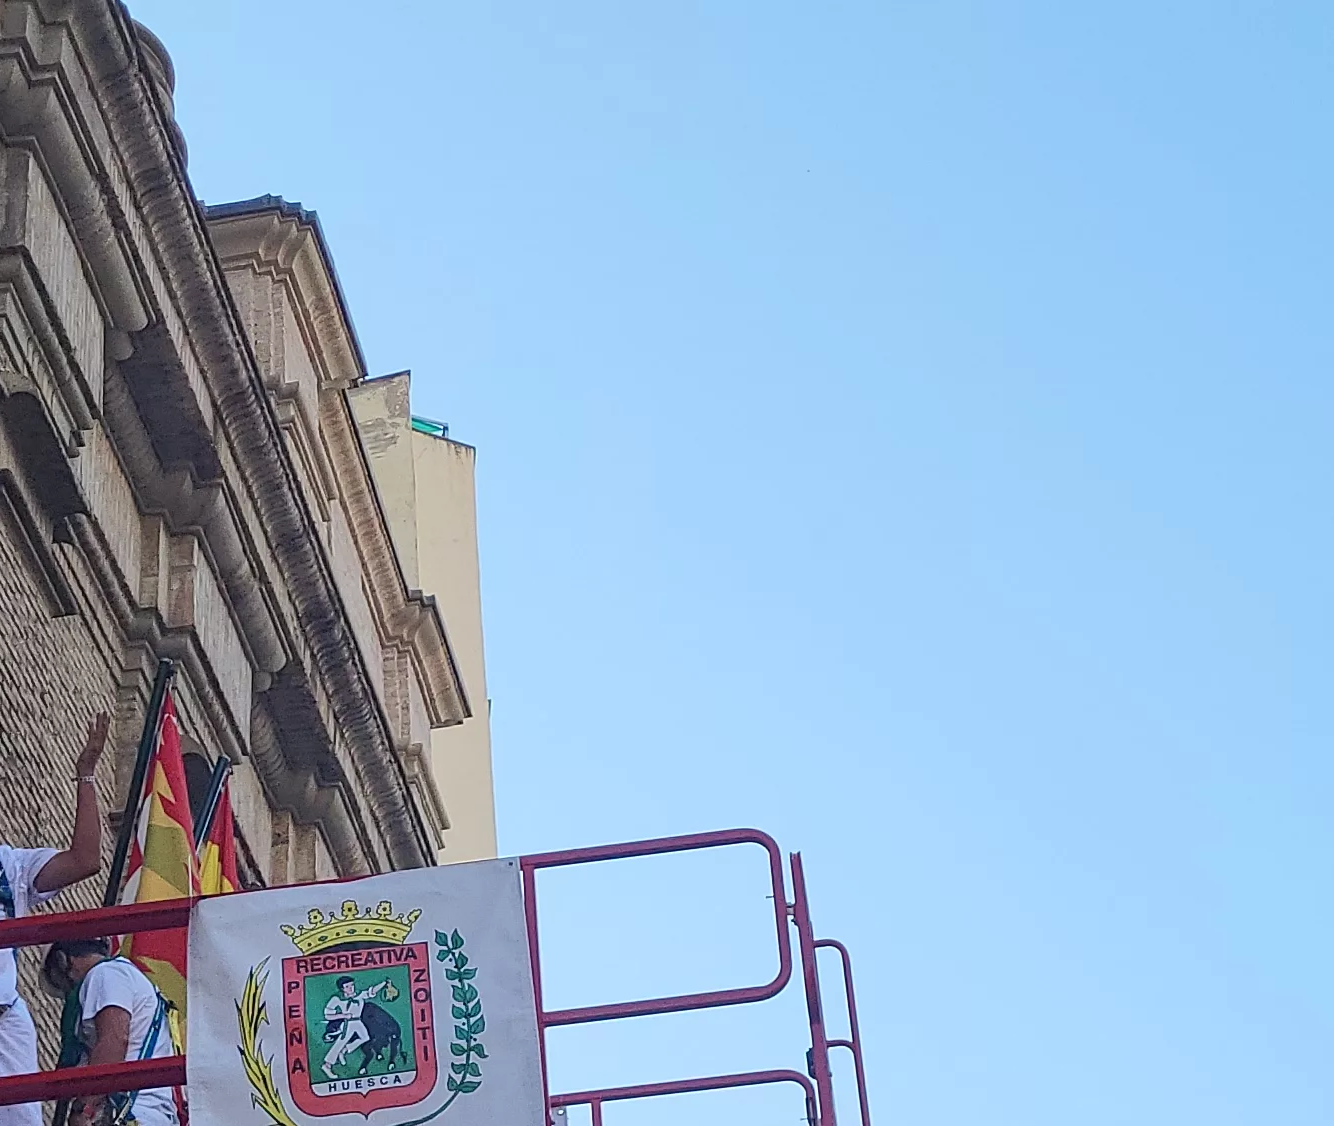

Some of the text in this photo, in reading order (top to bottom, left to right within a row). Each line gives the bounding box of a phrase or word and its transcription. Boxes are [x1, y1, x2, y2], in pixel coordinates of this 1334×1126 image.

[296, 947, 418, 974] RECREATIVA
[287, 981, 306, 1075] PEÑA
[412, 968, 430, 1062] ZOITI
[328, 1074, 403, 1093] HUESCA
